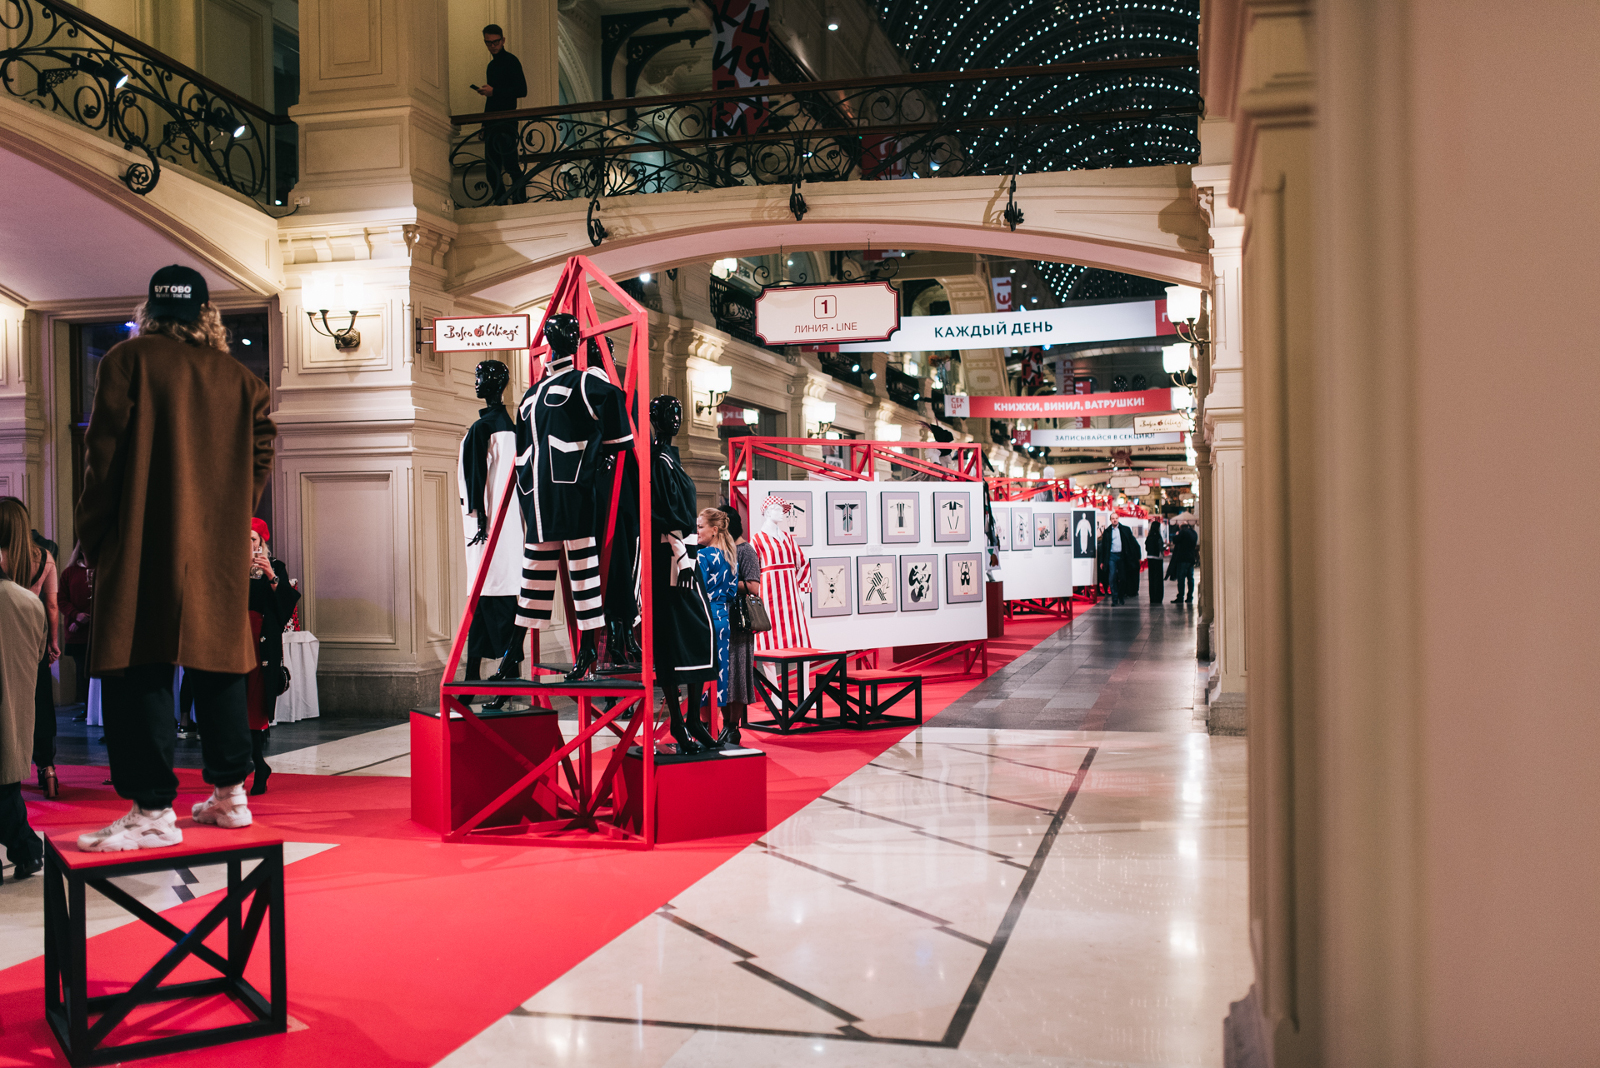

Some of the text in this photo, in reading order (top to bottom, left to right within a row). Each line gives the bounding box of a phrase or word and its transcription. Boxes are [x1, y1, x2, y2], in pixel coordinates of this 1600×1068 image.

[821, 299, 828, 314] 1
[794, 322, 858, 334] ЛИНИЯ LINE
[934, 320, 1053, 339] КАЖДЫЙ ДЕНЬ
[994, 397, 1145, 413] КНИЖКИ, ВИНИЛ, ВАТРУШКИ!
[1055, 434, 1112, 442] ЗАПИСЫВАЙСЯ
